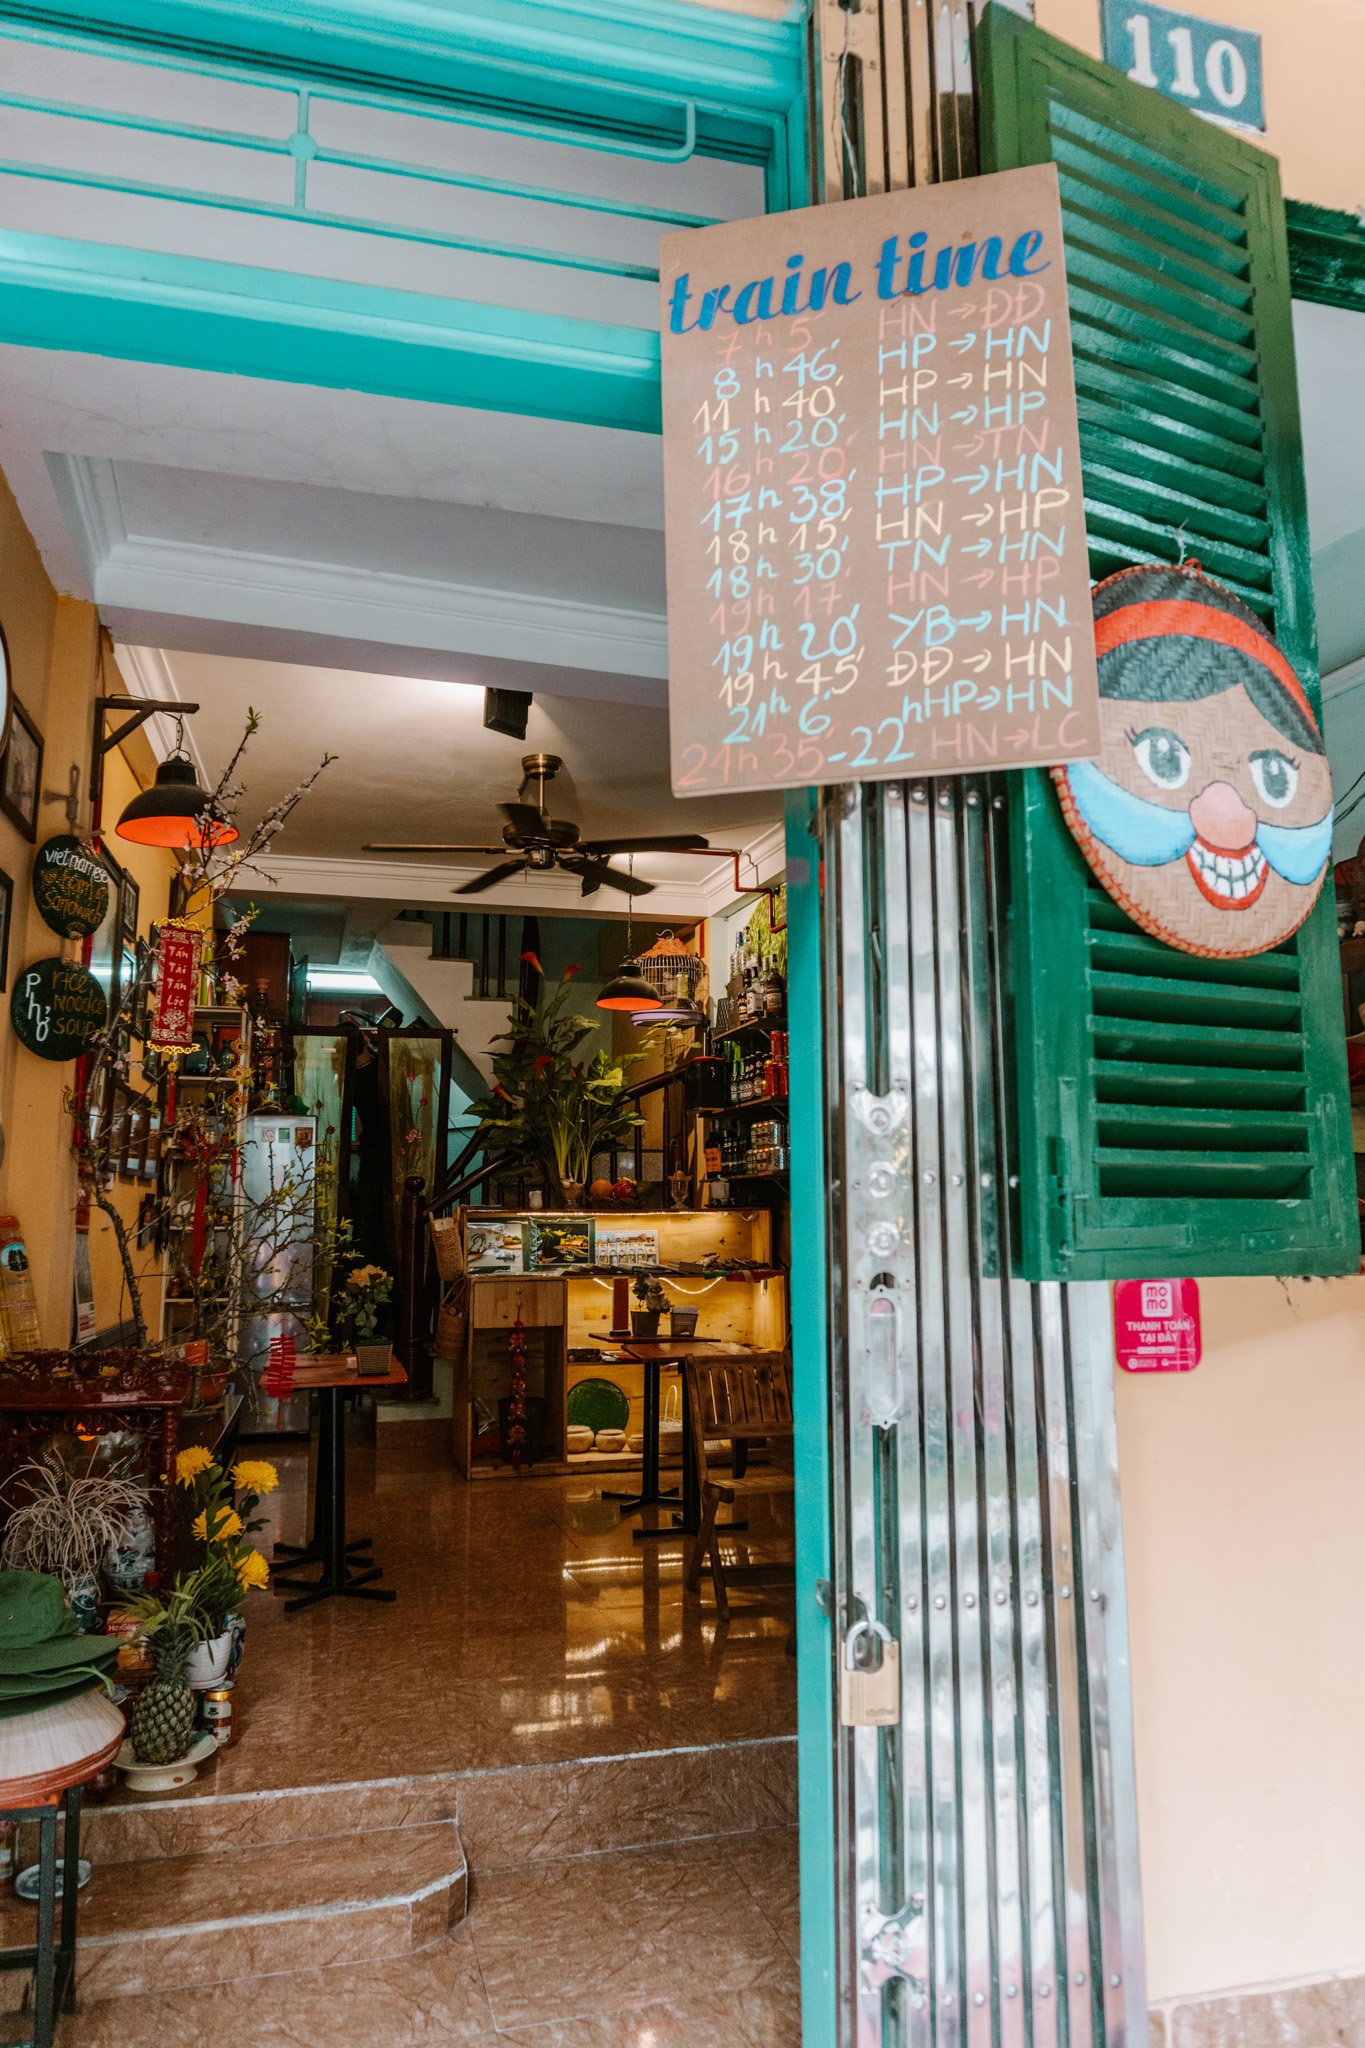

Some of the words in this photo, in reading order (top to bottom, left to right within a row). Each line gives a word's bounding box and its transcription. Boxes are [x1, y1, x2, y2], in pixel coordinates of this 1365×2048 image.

[1126, 14, 1247, 109] 110
[669, 254, 862, 335] train
[875, 230, 1052, 300] time
[879, 298, 938, 340] HN
[878, 333, 937, 374] HP
[985, 319, 1050, 360] HN
[879, 369, 937, 406] HP
[983, 356, 1046, 392] HN
[879, 401, 939, 440] HN
[984, 391, 1046, 429] HP
[879, 435, 942, 473] HN
[981, 419, 1049, 460] TN
[875, 465, 945, 509] HP
[994, 446, 1063, 493] HN
[876, 501, 944, 541] HN
[1000, 487, 1070, 534] HP
[878, 534, 952, 572] TN
[998, 525, 1066, 564] HN
[888, 566, 950, 605] HN
[1001, 556, 1060, 595] HP
[888, 605, 957, 649] YB
[1000, 594, 1067, 636] HN
[1005, 635, 1072, 679] HN
[923, 679, 978, 718] HP
[1006, 674, 1073, 714] HN
[930, 720, 998, 760] HN
[1031, 711, 1089, 750] LC
[1146, 1286, 1168, 1298] mo
[1147, 1299, 1169, 1310] mo
[1125, 1321, 1162, 1332] THANH
